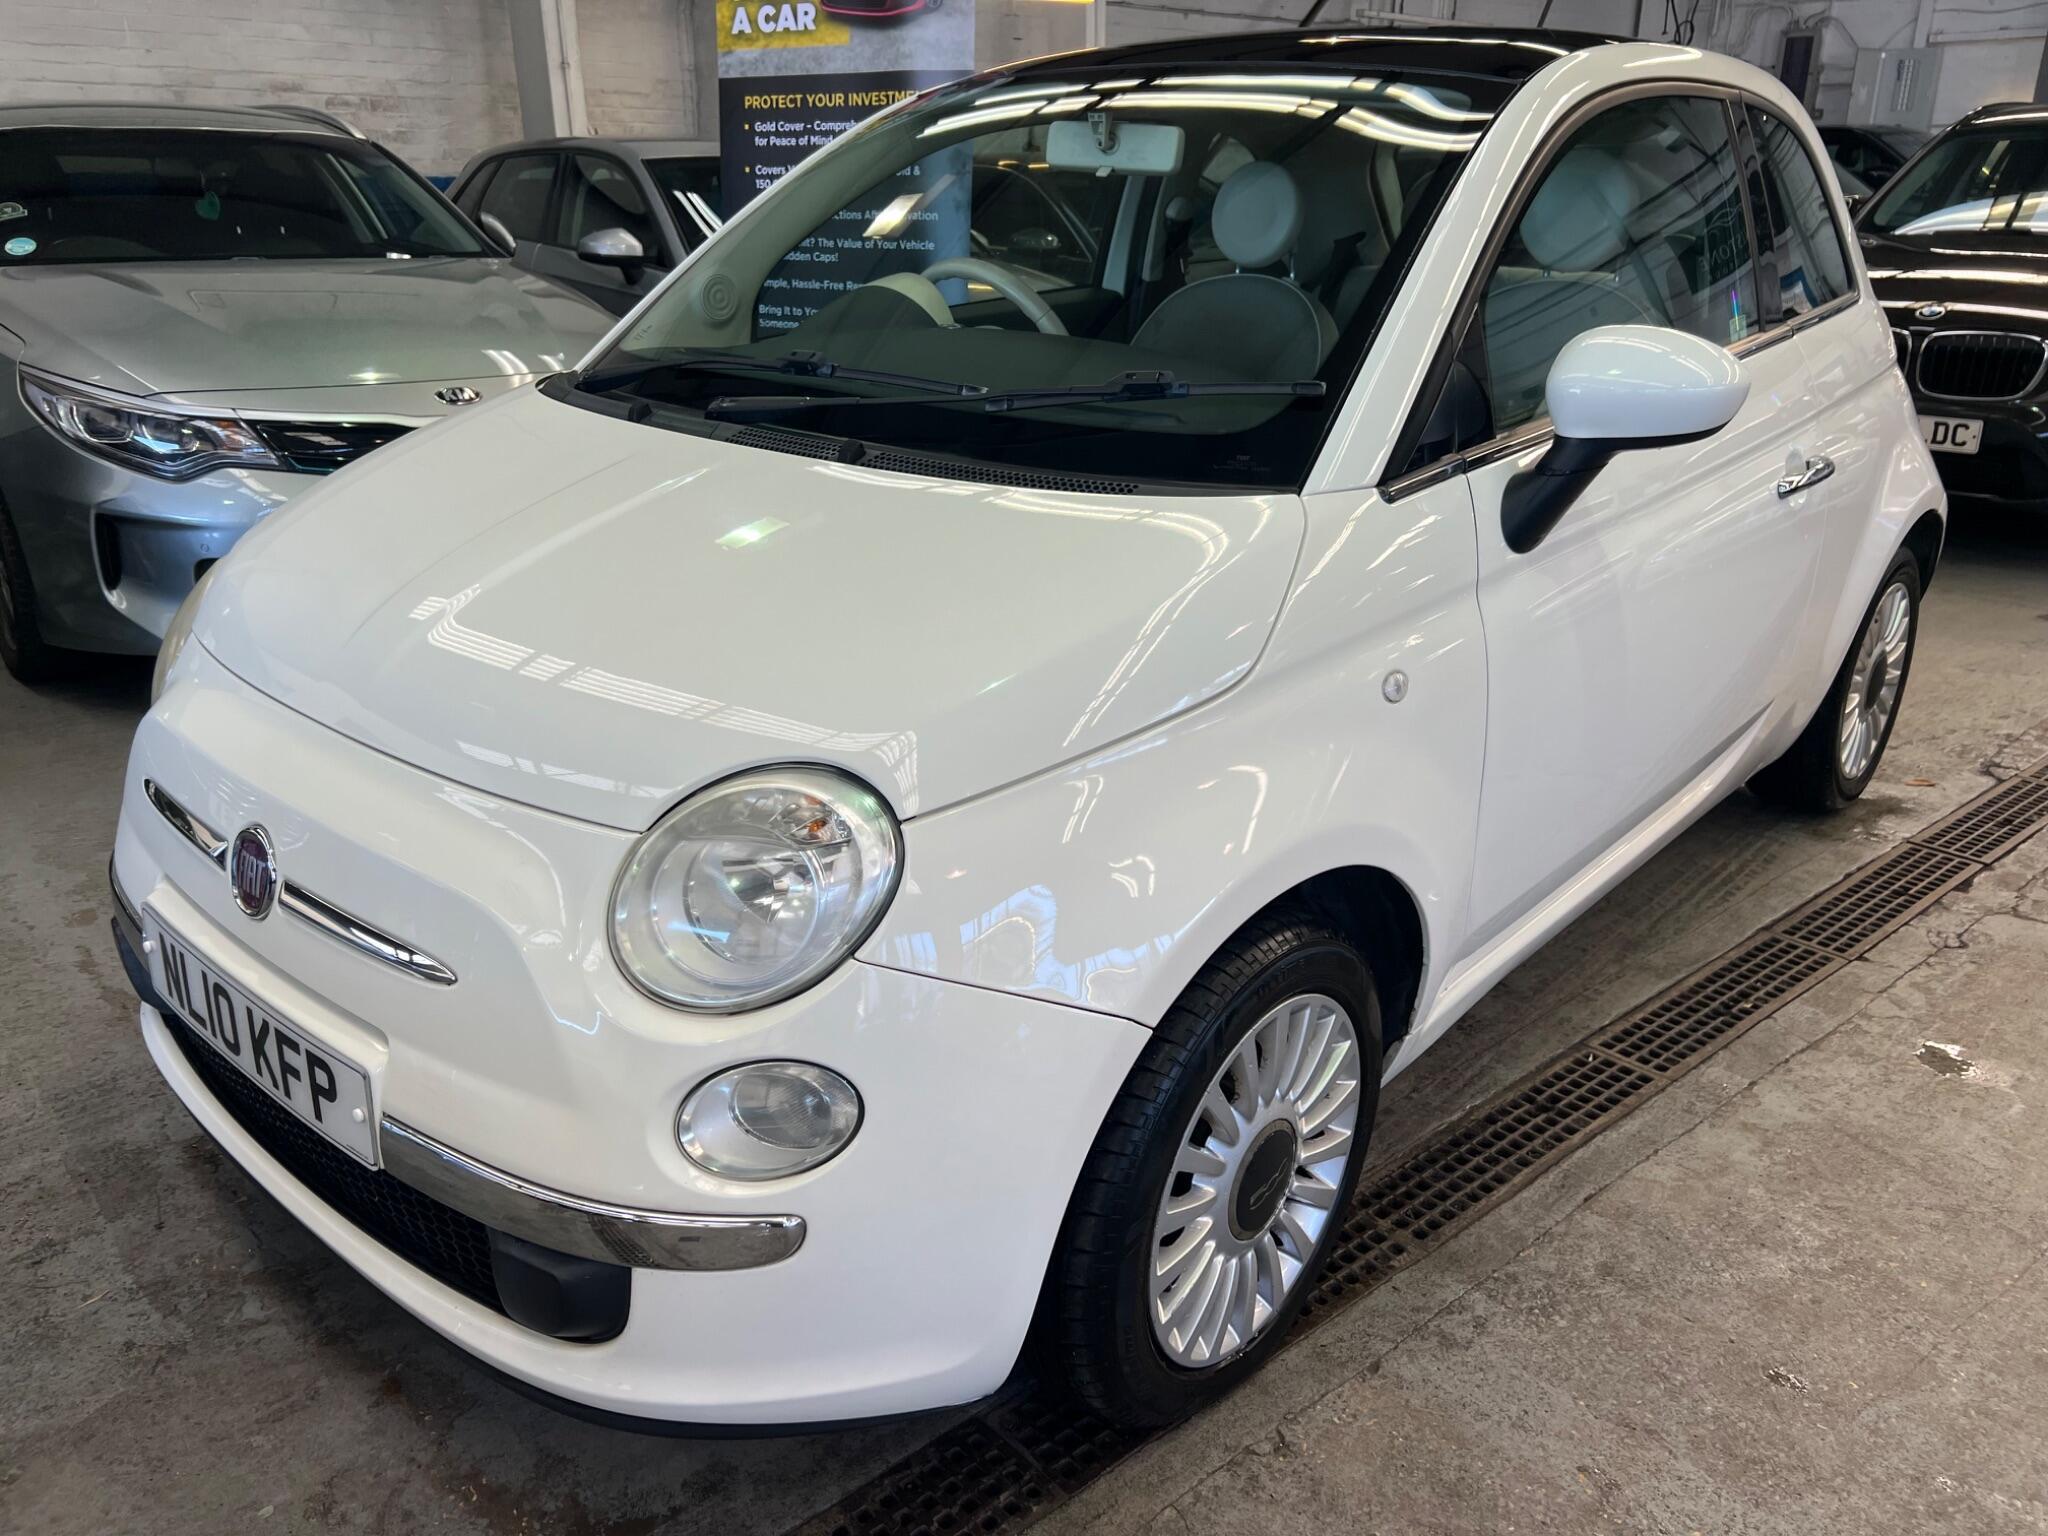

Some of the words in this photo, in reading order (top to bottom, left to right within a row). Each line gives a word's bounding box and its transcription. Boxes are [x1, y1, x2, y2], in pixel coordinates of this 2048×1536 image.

[731, 7, 752, 34] A
[758, 3, 816, 33] CAR
[744, 95, 803, 109] PROTECT
[806, 92, 845, 107] YOUR
[848, 90, 918, 106] INVESTME
[754, 121, 776, 132] Gold
[777, 121, 805, 131] Cover
[754, 136, 768, 146] for
[769, 136, 797, 146] Peace
[798, 135, 808, 146] of
[755, 165, 786, 175] Covers
[817, 238, 835, 248] The
[836, 238, 863, 249] Value
[864, 239, 875, 249] of
[876, 240, 898, 250] Your
[900, 240, 936, 250] Vehicle
[792, 279, 844, 290] Hassle-Free
[759, 304, 782, 316] Bring
[792, 306, 802, 316] to
[442, 387, 477, 401] KIA
[1925, 421, 1970, 447] DC
[238, 848, 267, 899] FIAT
[158, 932, 242, 1057] NL10
[246, 1006, 337, 1124] KFP
